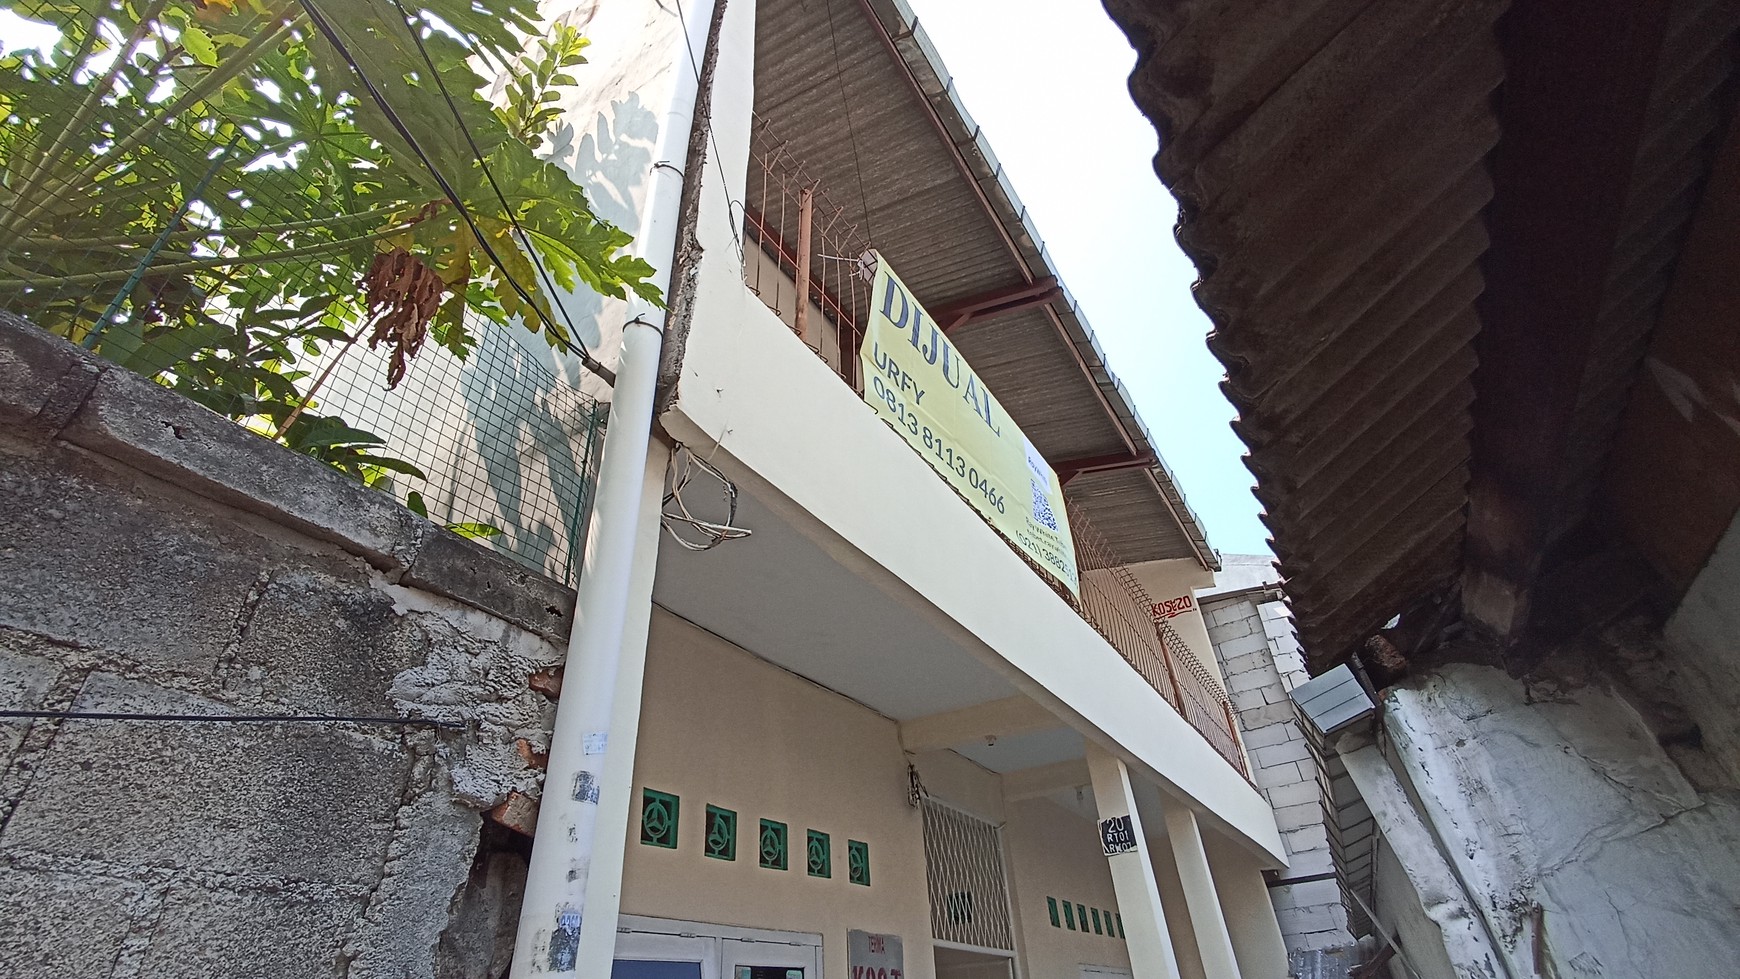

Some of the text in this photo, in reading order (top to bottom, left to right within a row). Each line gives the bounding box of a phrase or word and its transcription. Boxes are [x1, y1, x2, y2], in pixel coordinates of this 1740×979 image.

[874, 342, 925, 405] URFY
[879, 271, 1001, 438] DIJUAL
[873, 376, 918, 436] 0813
[922, 426, 966, 478] 8113
[968, 467, 1005, 515] 0466
[1015, 529, 1042, 558] (021)
[1106, 830, 1129, 843] RT01
[1107, 817, 1124, 833] 20
